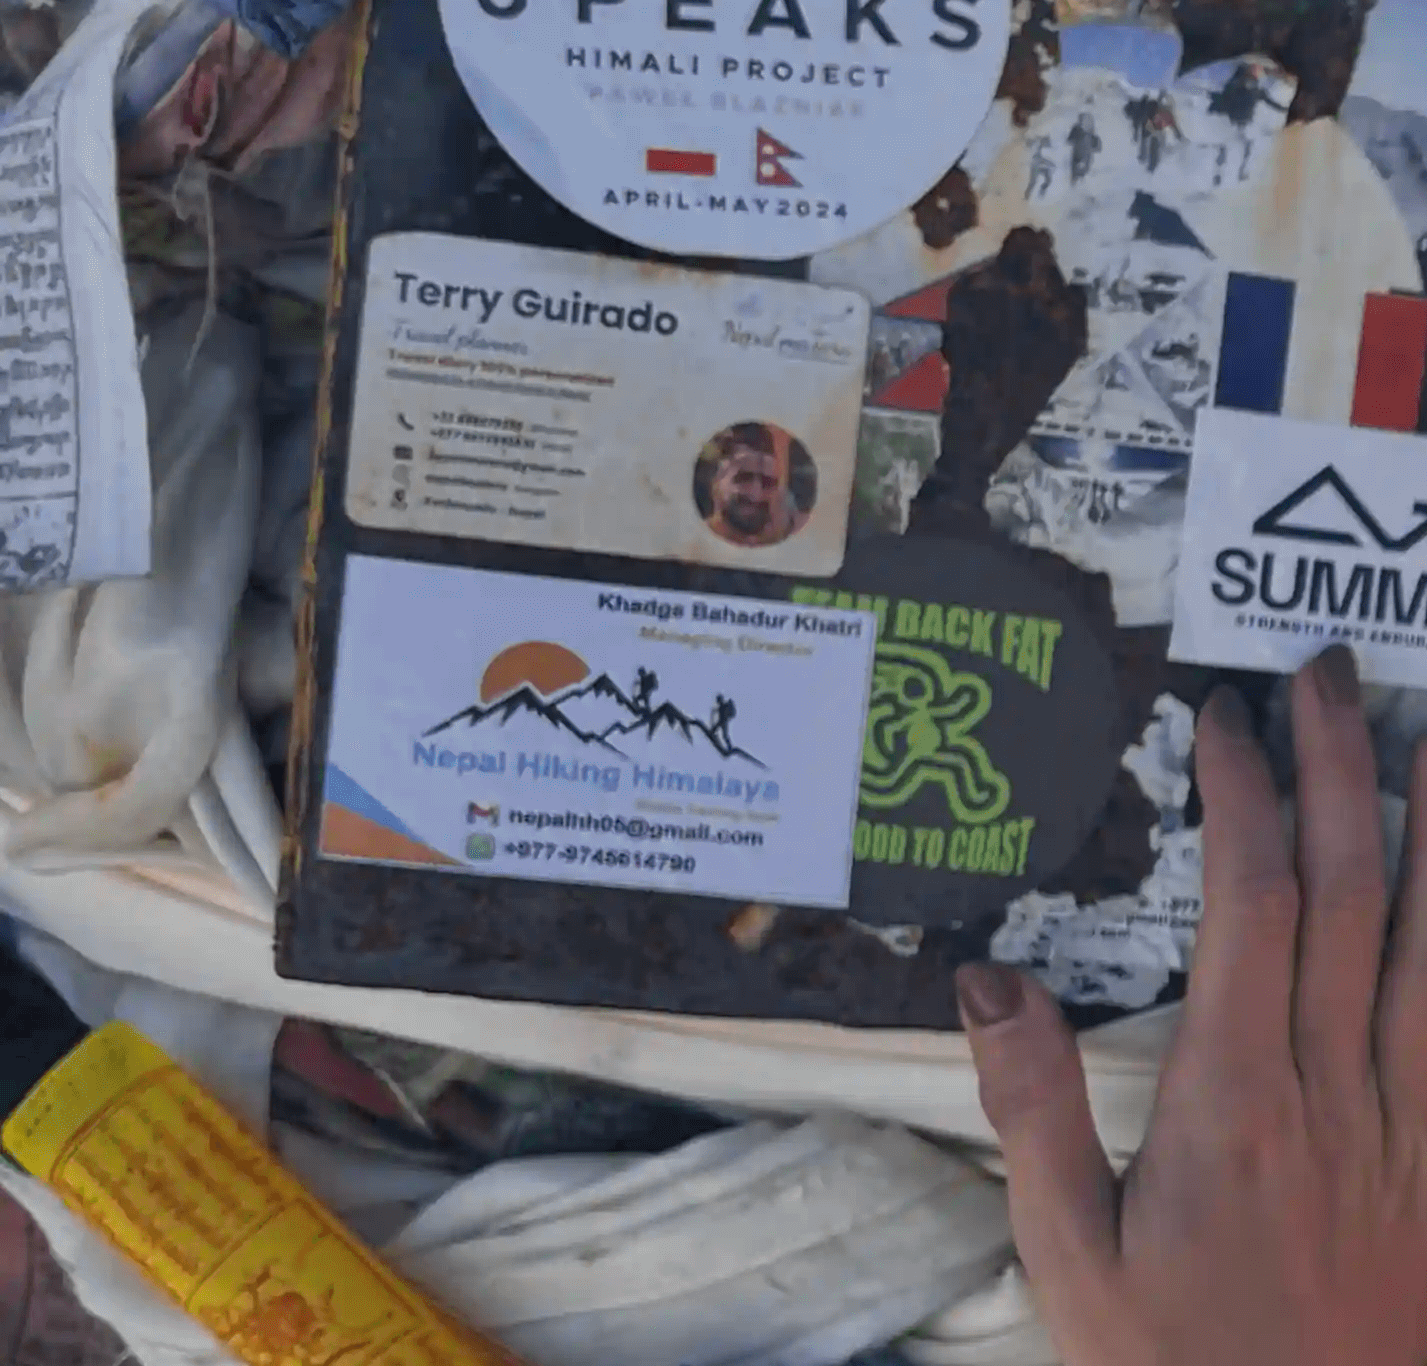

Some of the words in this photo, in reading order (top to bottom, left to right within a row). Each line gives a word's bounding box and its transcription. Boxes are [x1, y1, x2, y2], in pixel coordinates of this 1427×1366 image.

[566, 47, 699, 76] HIMALI
[722, 57, 890, 89] PROJECT
[394, 270, 504, 324] Terry
[512, 288, 679, 336] Guirado
[691, 601, 790, 630] Bahadur
[897, 600, 996, 658] BACK
[1001, 613, 1063, 693] FAT
[413, 741, 507, 776] Nepal
[517, 752, 621, 793] Hiking
[633, 764, 781, 803] Himalaya
[853, 819, 907, 865] OOD
[913, 826, 945, 870] TO
[949, 815, 1036, 877] COAST
